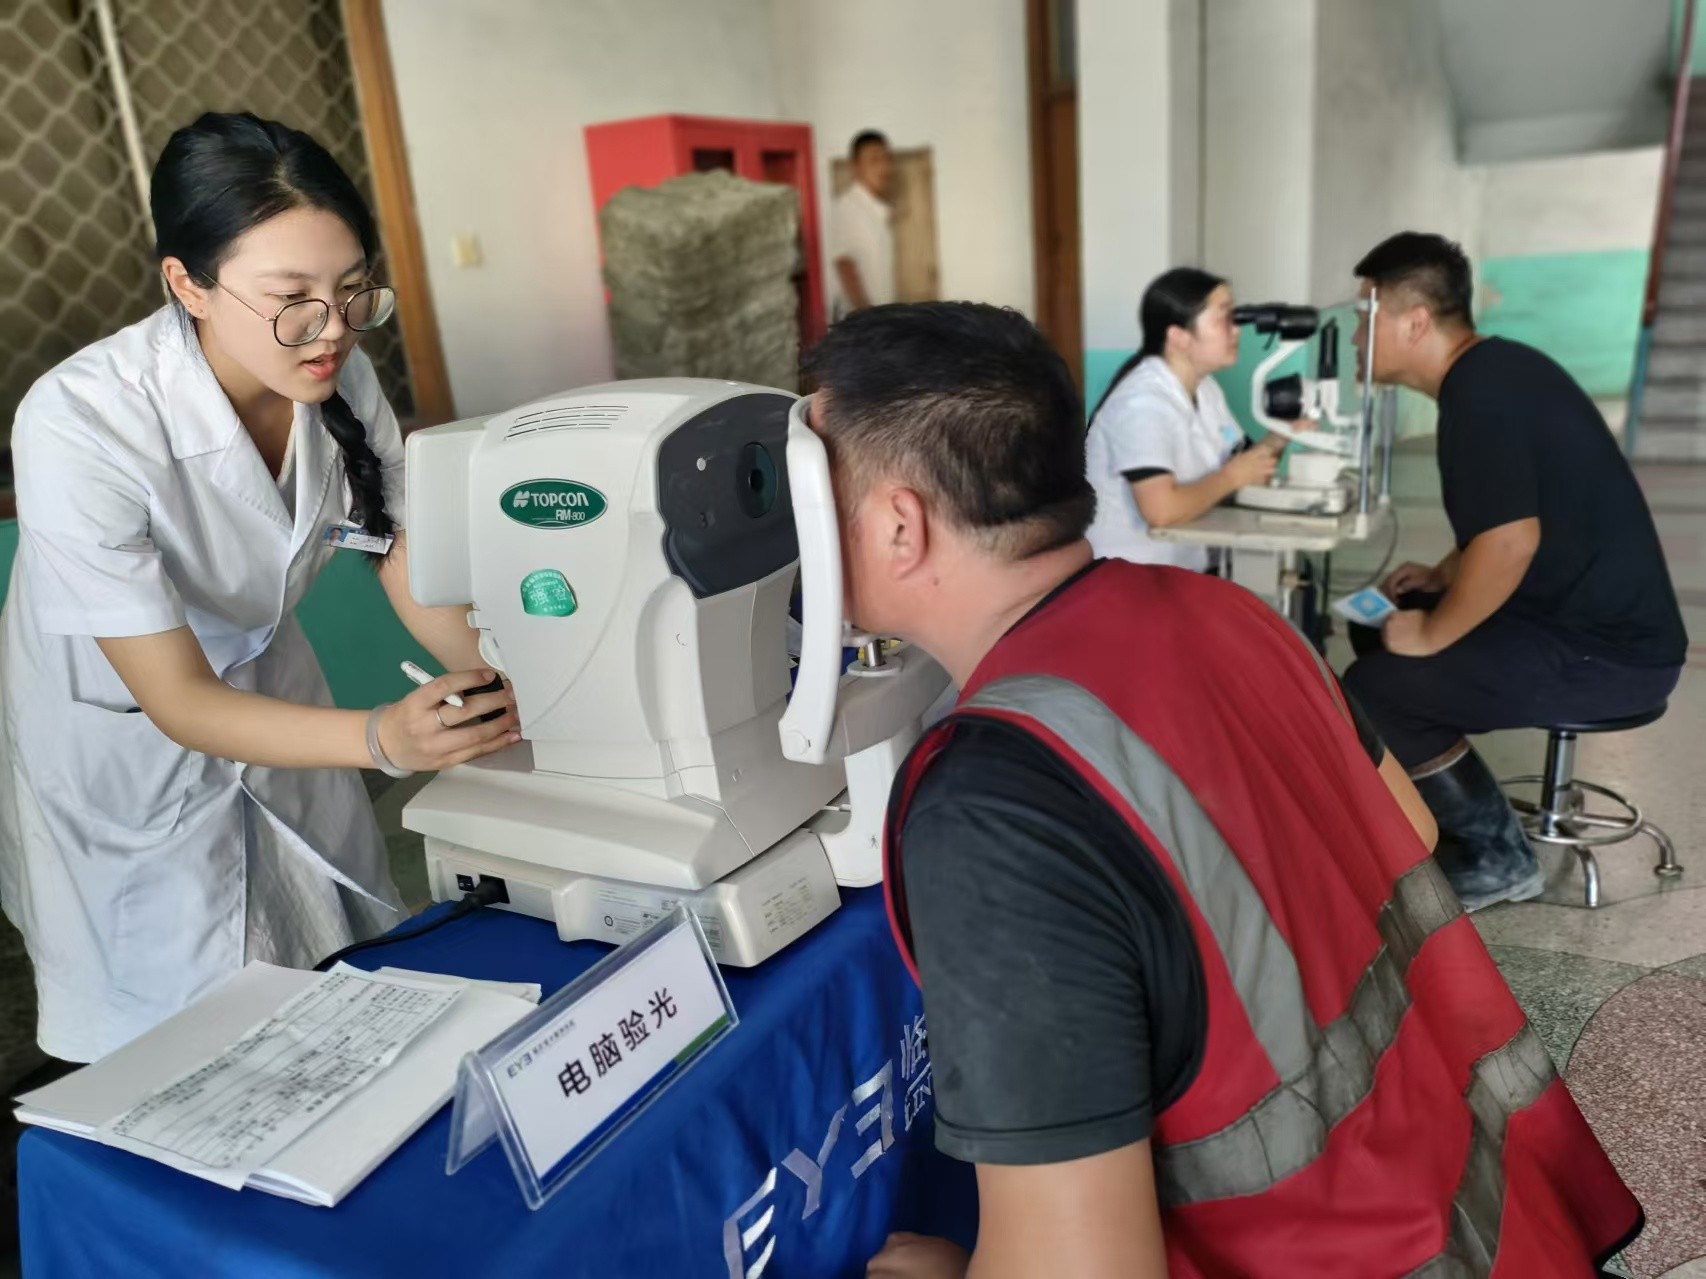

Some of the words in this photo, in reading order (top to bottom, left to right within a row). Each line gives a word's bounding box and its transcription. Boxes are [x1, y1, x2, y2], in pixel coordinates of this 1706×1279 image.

[531, 492, 589, 507] TOPCON
[555, 508, 586, 521] RM-800
[558, 987, 677, 1097] 电脑验光
